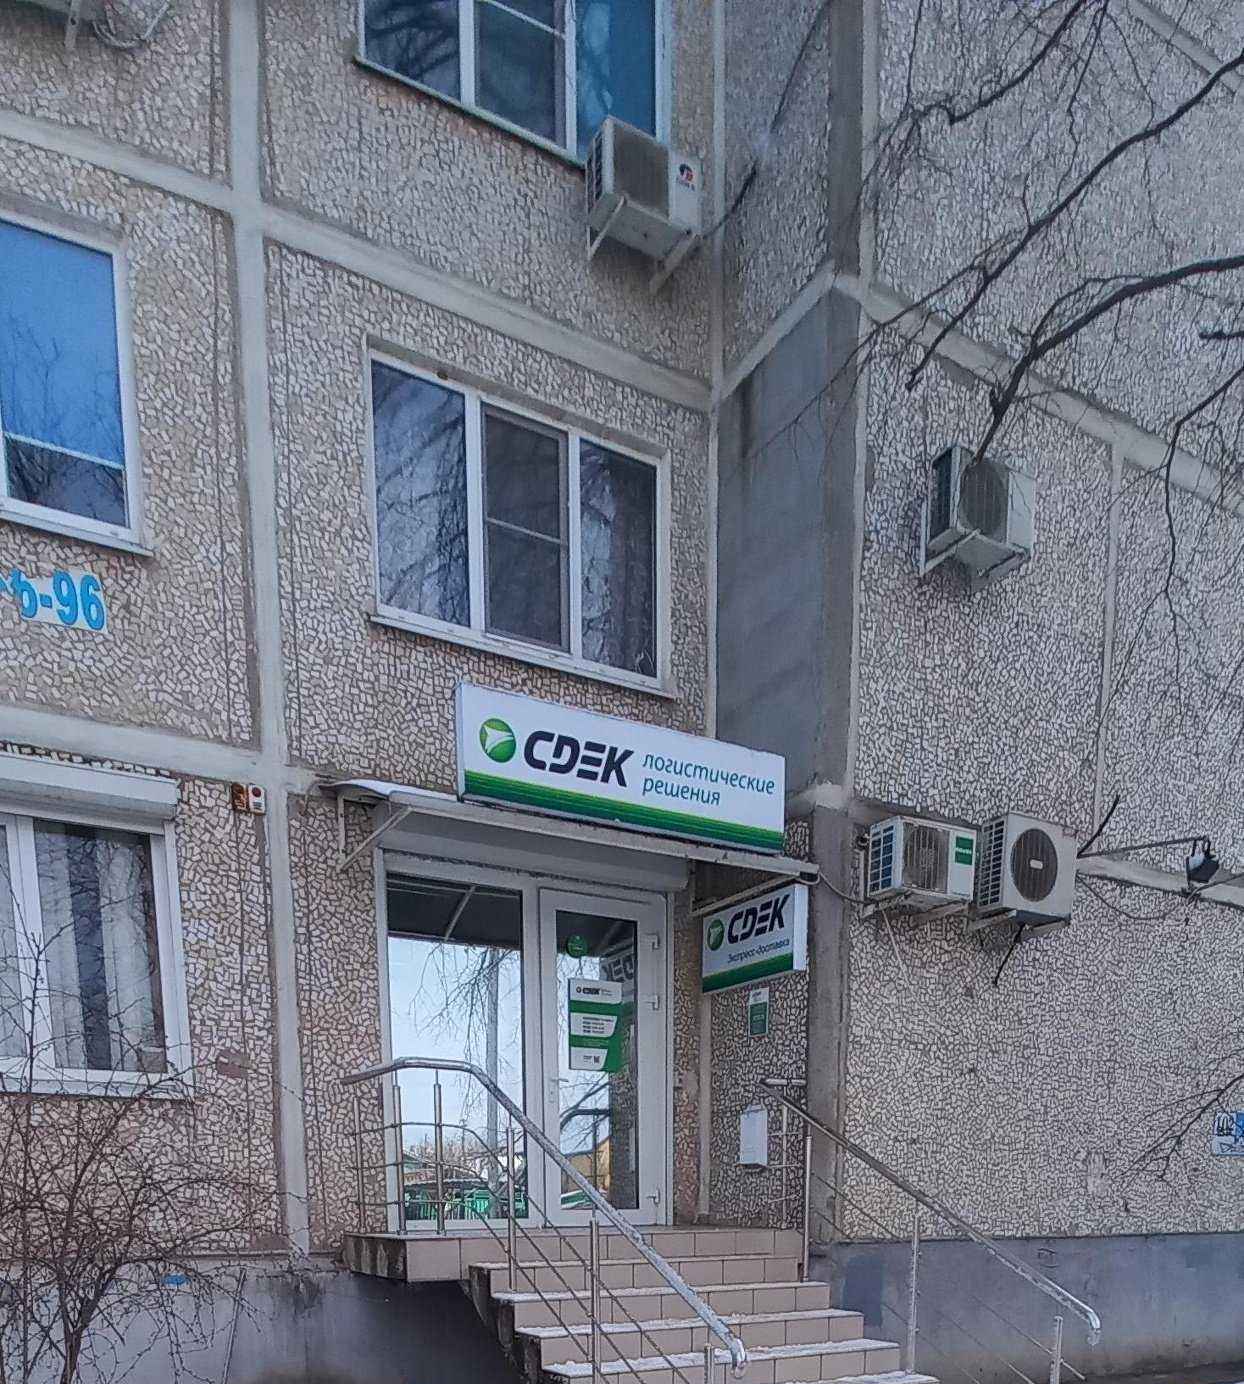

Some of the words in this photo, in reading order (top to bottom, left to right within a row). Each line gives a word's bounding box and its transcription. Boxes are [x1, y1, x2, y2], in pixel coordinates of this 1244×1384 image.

[523, 730, 635, 788] CDEK
[642, 752, 776, 795] логистические
[642, 775, 721, 807] решения
[727, 893, 791, 945] CDEK
